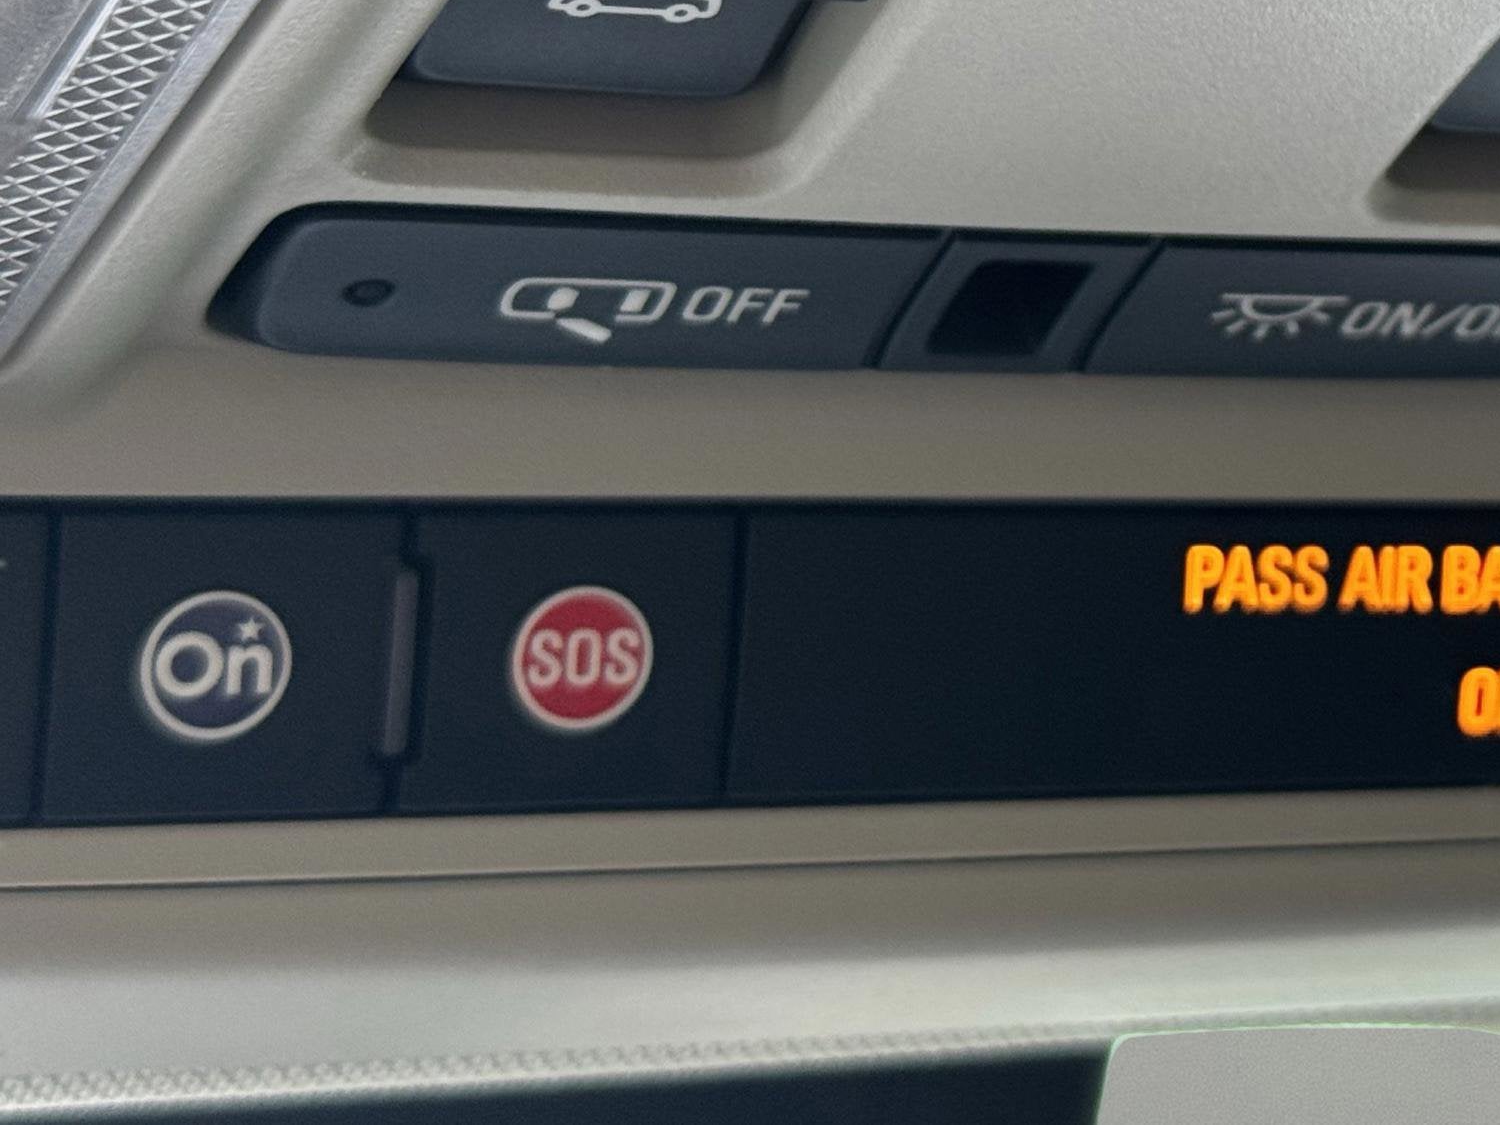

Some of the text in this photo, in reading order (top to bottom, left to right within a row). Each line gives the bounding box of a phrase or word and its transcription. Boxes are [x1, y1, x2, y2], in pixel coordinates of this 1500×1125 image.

[682, 285, 810, 324] OFF
[1183, 544, 1329, 615] PASS
[1338, 544, 1433, 613] AIR
[155, 630, 274, 699] On
[527, 627, 643, 687] SOS
